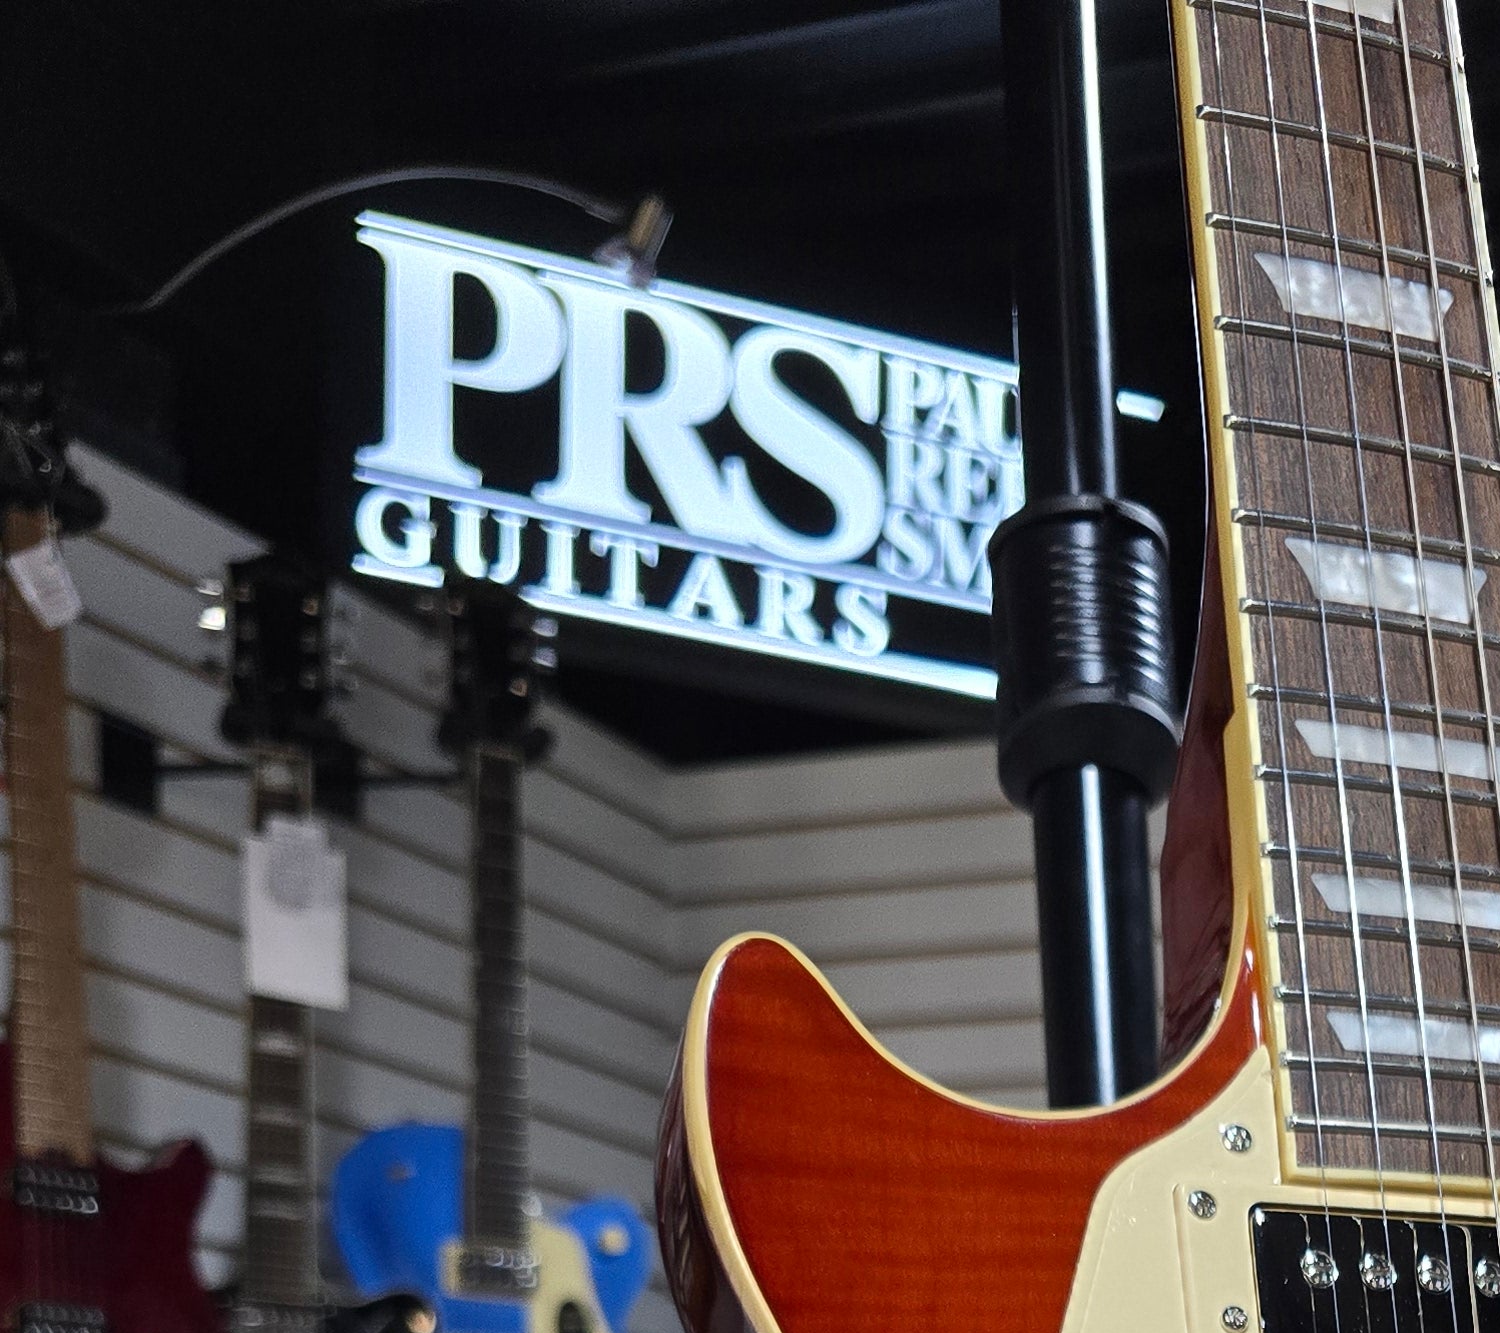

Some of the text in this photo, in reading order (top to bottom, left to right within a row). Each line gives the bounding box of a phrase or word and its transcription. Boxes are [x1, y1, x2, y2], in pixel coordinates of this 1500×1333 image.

[356, 227, 886, 564] PRS
[880, 354, 1023, 459] PAU
[356, 486, 890, 656] GUITARS
